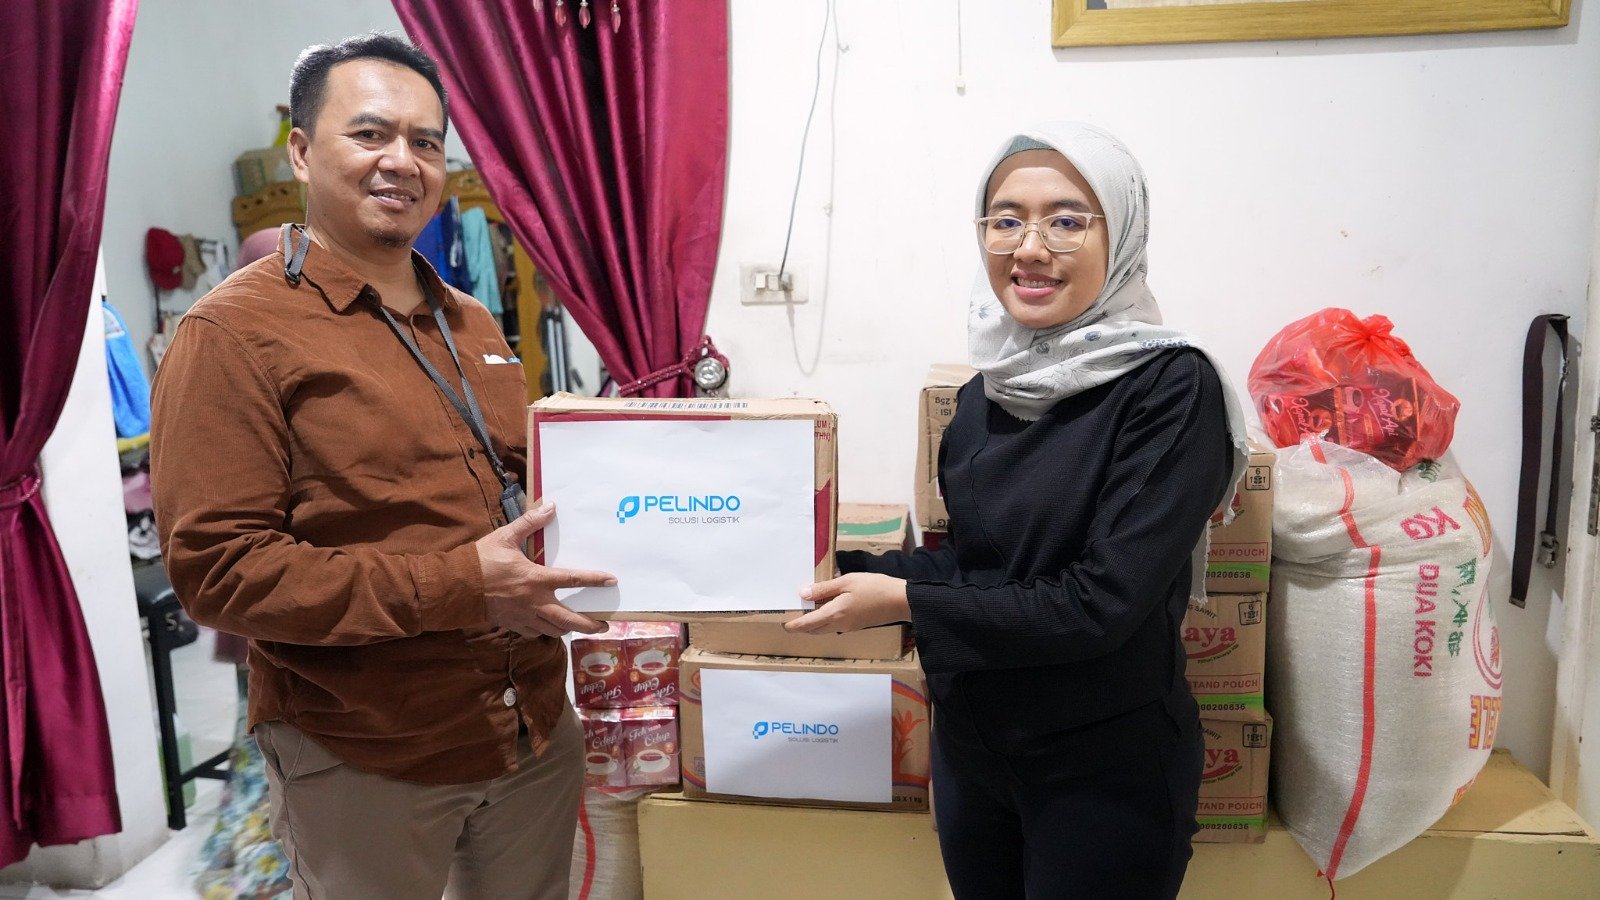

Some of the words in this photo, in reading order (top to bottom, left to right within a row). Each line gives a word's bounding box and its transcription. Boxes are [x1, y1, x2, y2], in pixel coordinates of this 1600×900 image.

[644, 495, 741, 512] PELINDO
[668, 516, 699, 524] SOLUSI
[701, 516, 741, 524] LOGISTIK
[1400, 505, 1461, 540] KG
[1207, 548, 1226, 557] ND
[1228, 548, 1265, 557] POUCH
[1414, 563, 1441, 615] DUA
[1194, 605, 1217, 619] SAWIT
[1184, 626, 1237, 648] aya
[1413, 619, 1437, 678] KOKI
[1222, 680, 1258, 689] POUCH
[1198, 703, 1246, 711] 00200636
[771, 722, 839, 735] PELINDO
[1205, 748, 1240, 769] ya
[1200, 802, 1225, 810] TAND
[1227, 801, 1263, 810] POUCH
